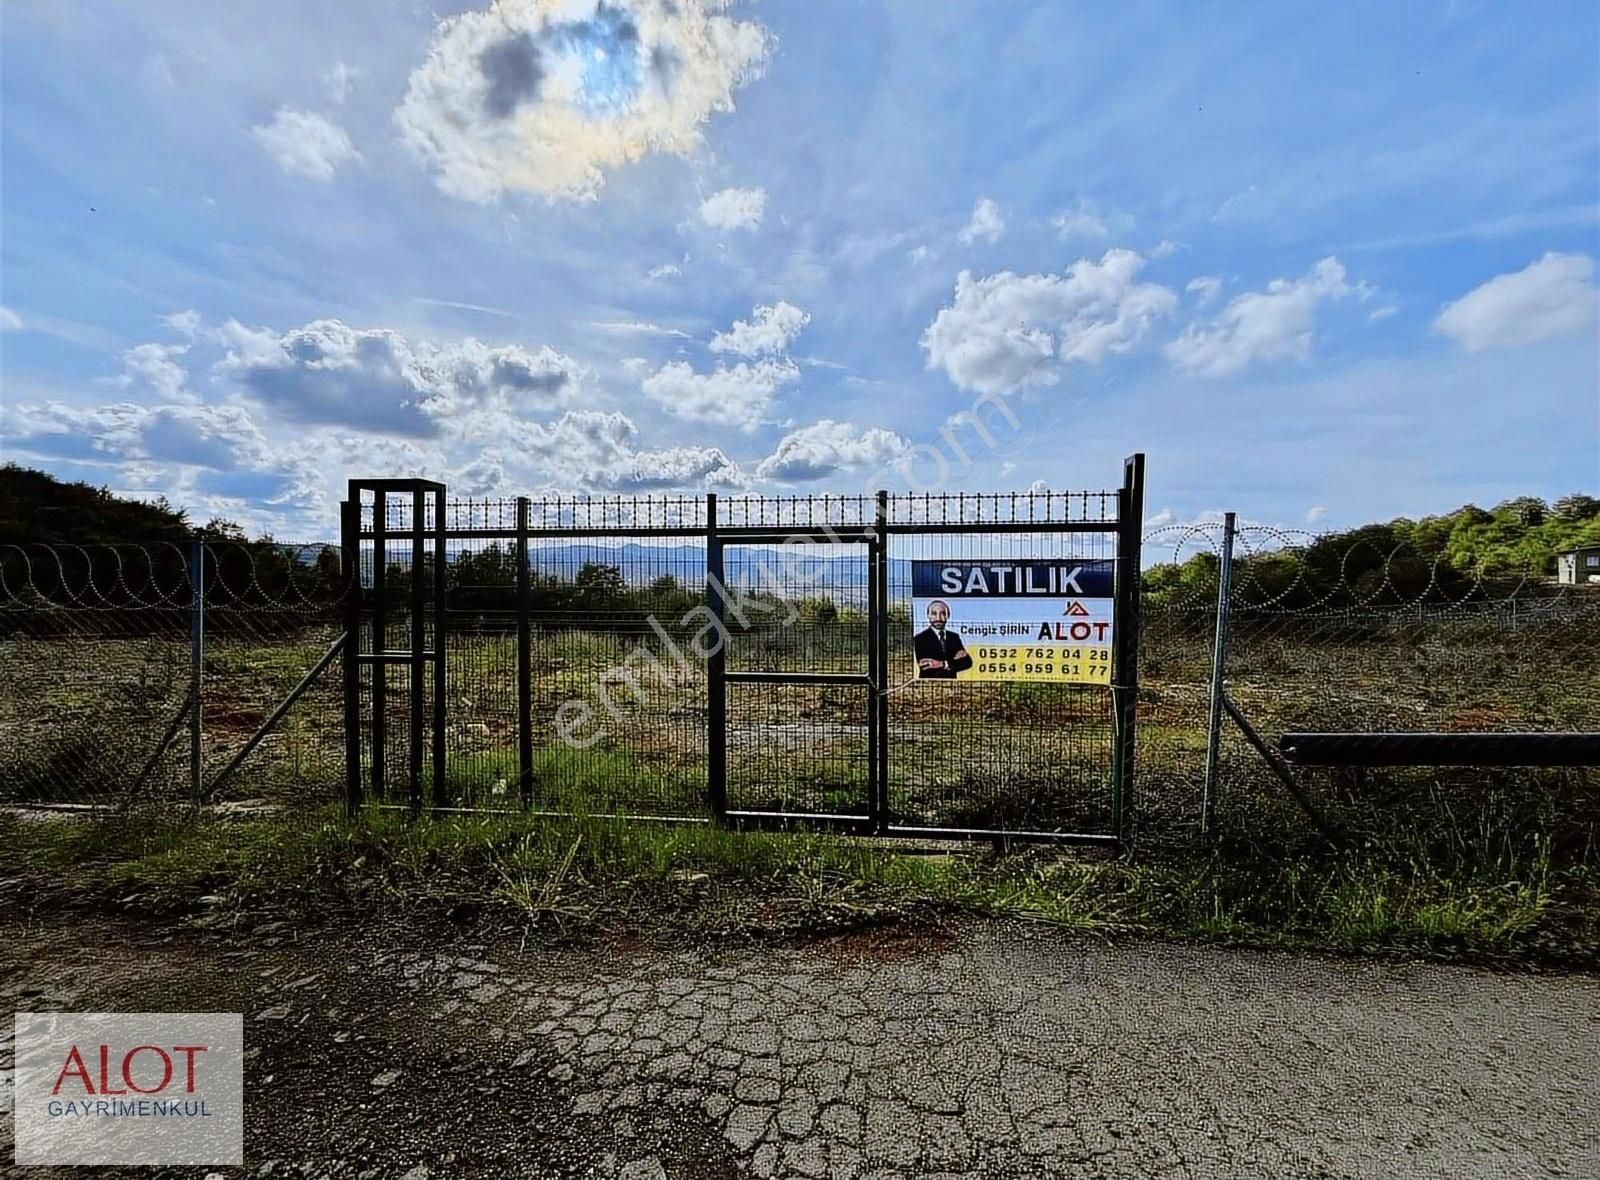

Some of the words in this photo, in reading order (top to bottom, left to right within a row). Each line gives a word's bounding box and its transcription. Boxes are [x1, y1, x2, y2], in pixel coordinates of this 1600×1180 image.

[941, 566, 1084, 594] SATILIK
[960, 625, 998, 637] Cengiz
[999, 623, 1030, 637] ŞİRİN
[1037, 621, 1110, 641] ALOT
[979, 648, 1018, 659] 0532
[1025, 648, 1055, 660] 762
[1062, 649, 1081, 660] 04
[1089, 650, 1108, 661] 28
[978, 663, 1017, 673] 0554
[1024, 663, 1053, 674] 959
[1061, 664, 1080, 675] 61
[1088, 665, 1108, 676] 77
